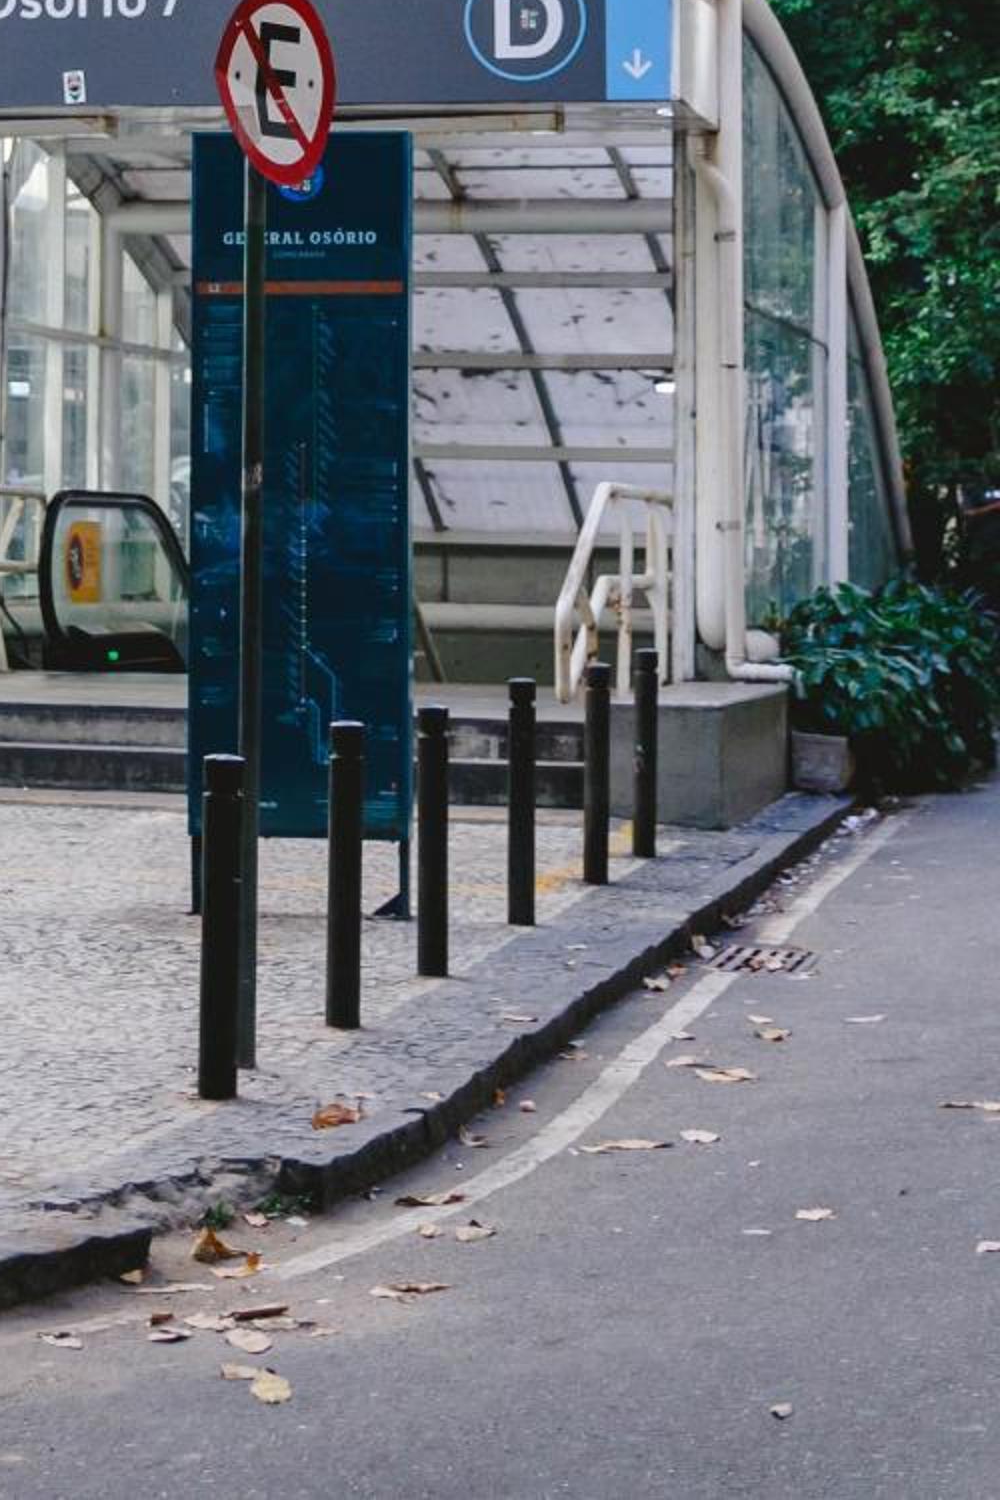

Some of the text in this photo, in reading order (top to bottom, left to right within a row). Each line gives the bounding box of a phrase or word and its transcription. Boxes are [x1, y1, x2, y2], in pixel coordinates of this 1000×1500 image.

[254, 21, 300, 141] E
[223, 228, 377, 245] GERAL OSÓRIO
